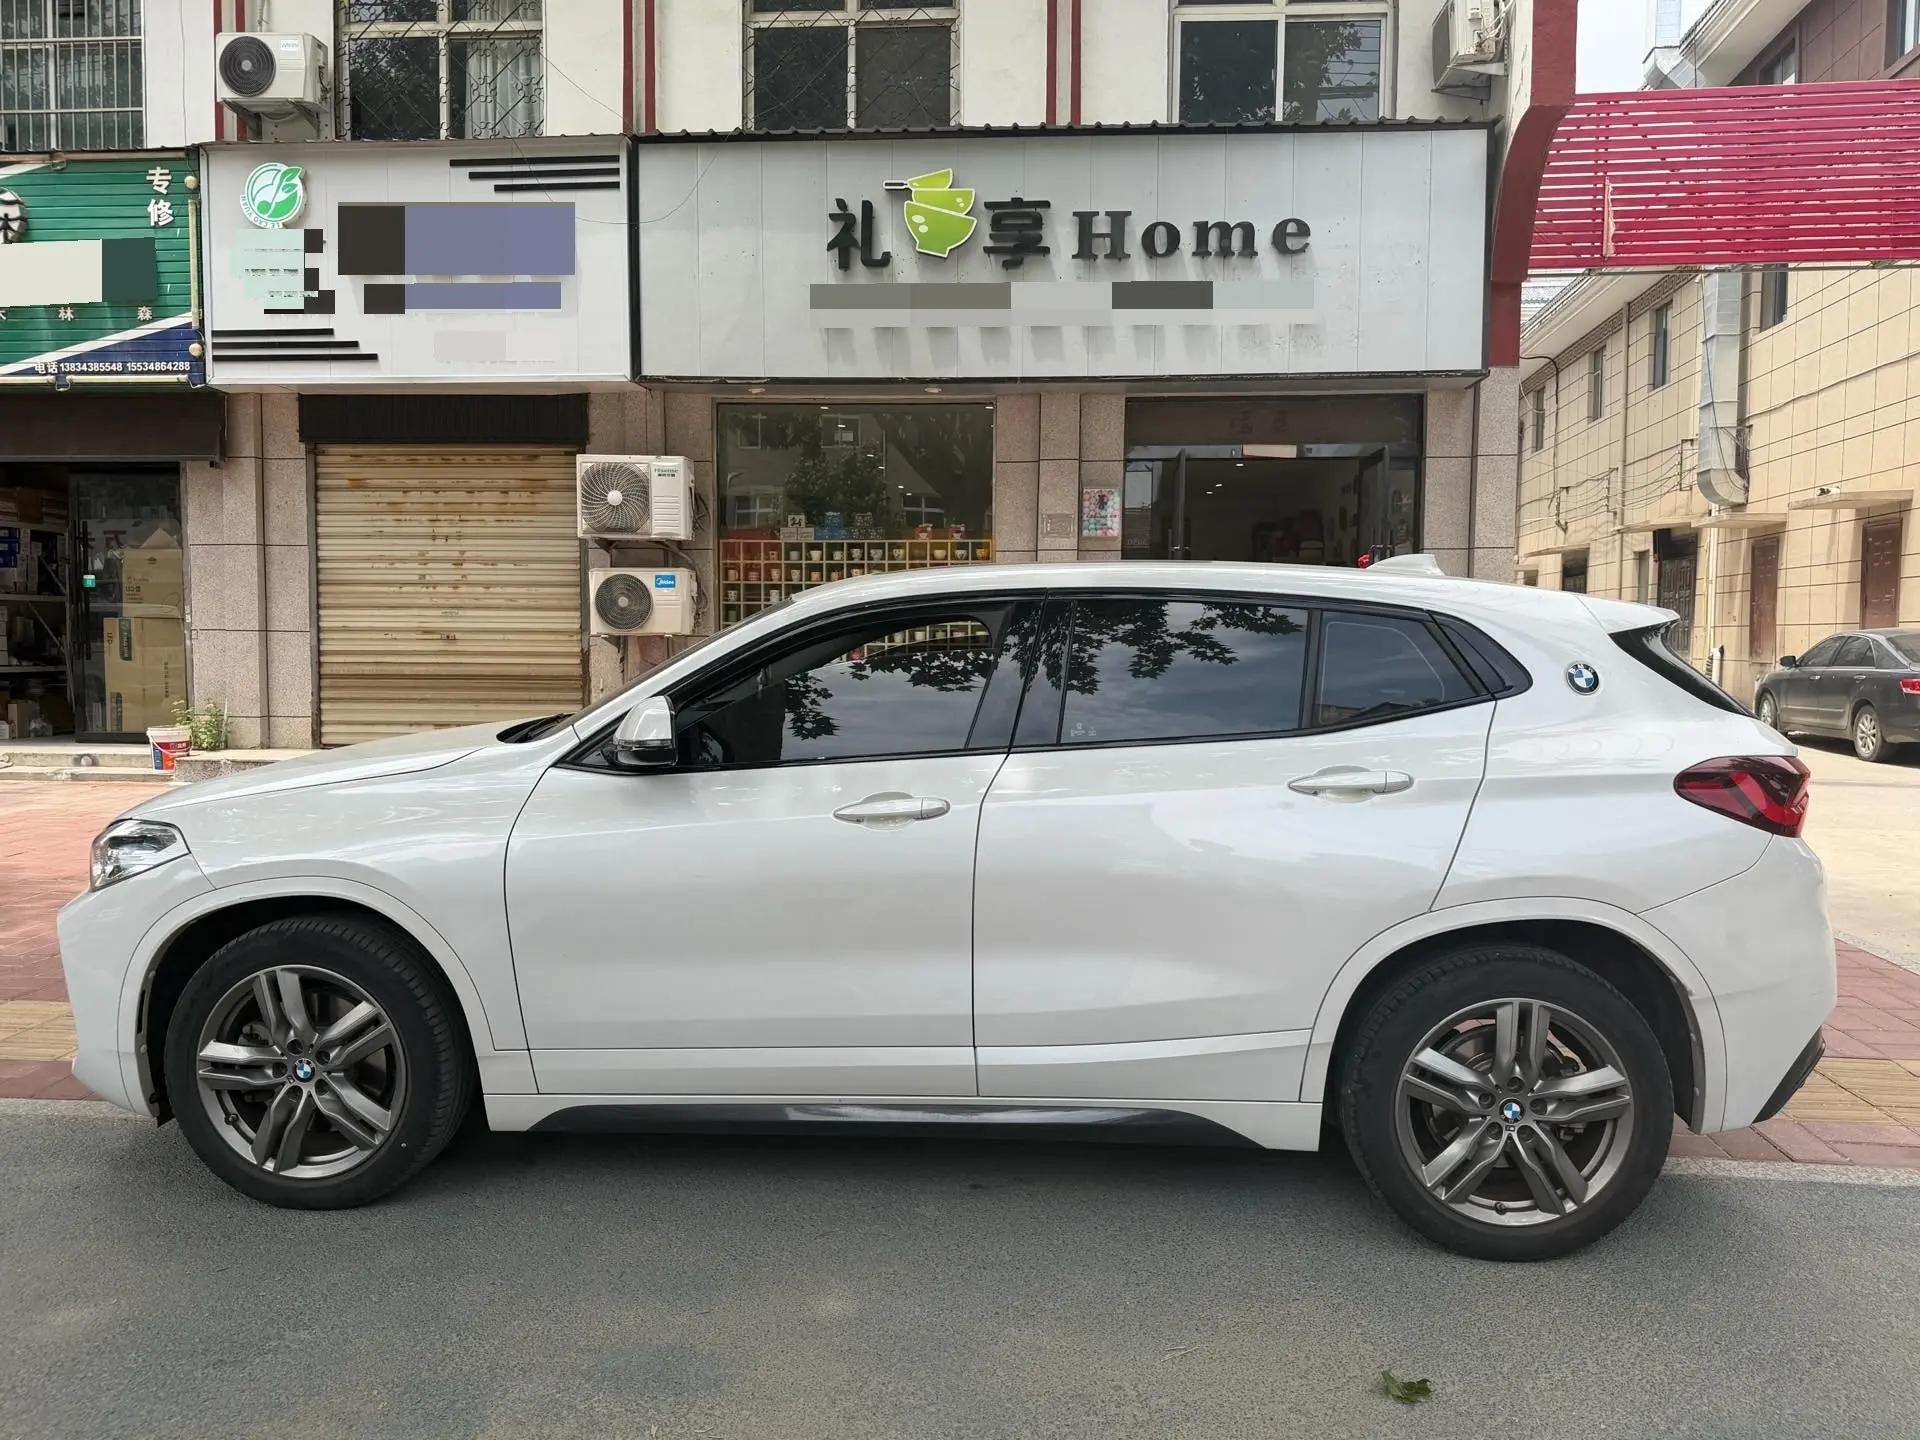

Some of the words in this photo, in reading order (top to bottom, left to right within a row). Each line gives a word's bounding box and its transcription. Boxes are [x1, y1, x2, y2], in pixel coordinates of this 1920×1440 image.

[146, 166, 174, 227] 专修
[1071, 210, 1312, 260] Home
[126, 361, 191, 372] 15534864288
